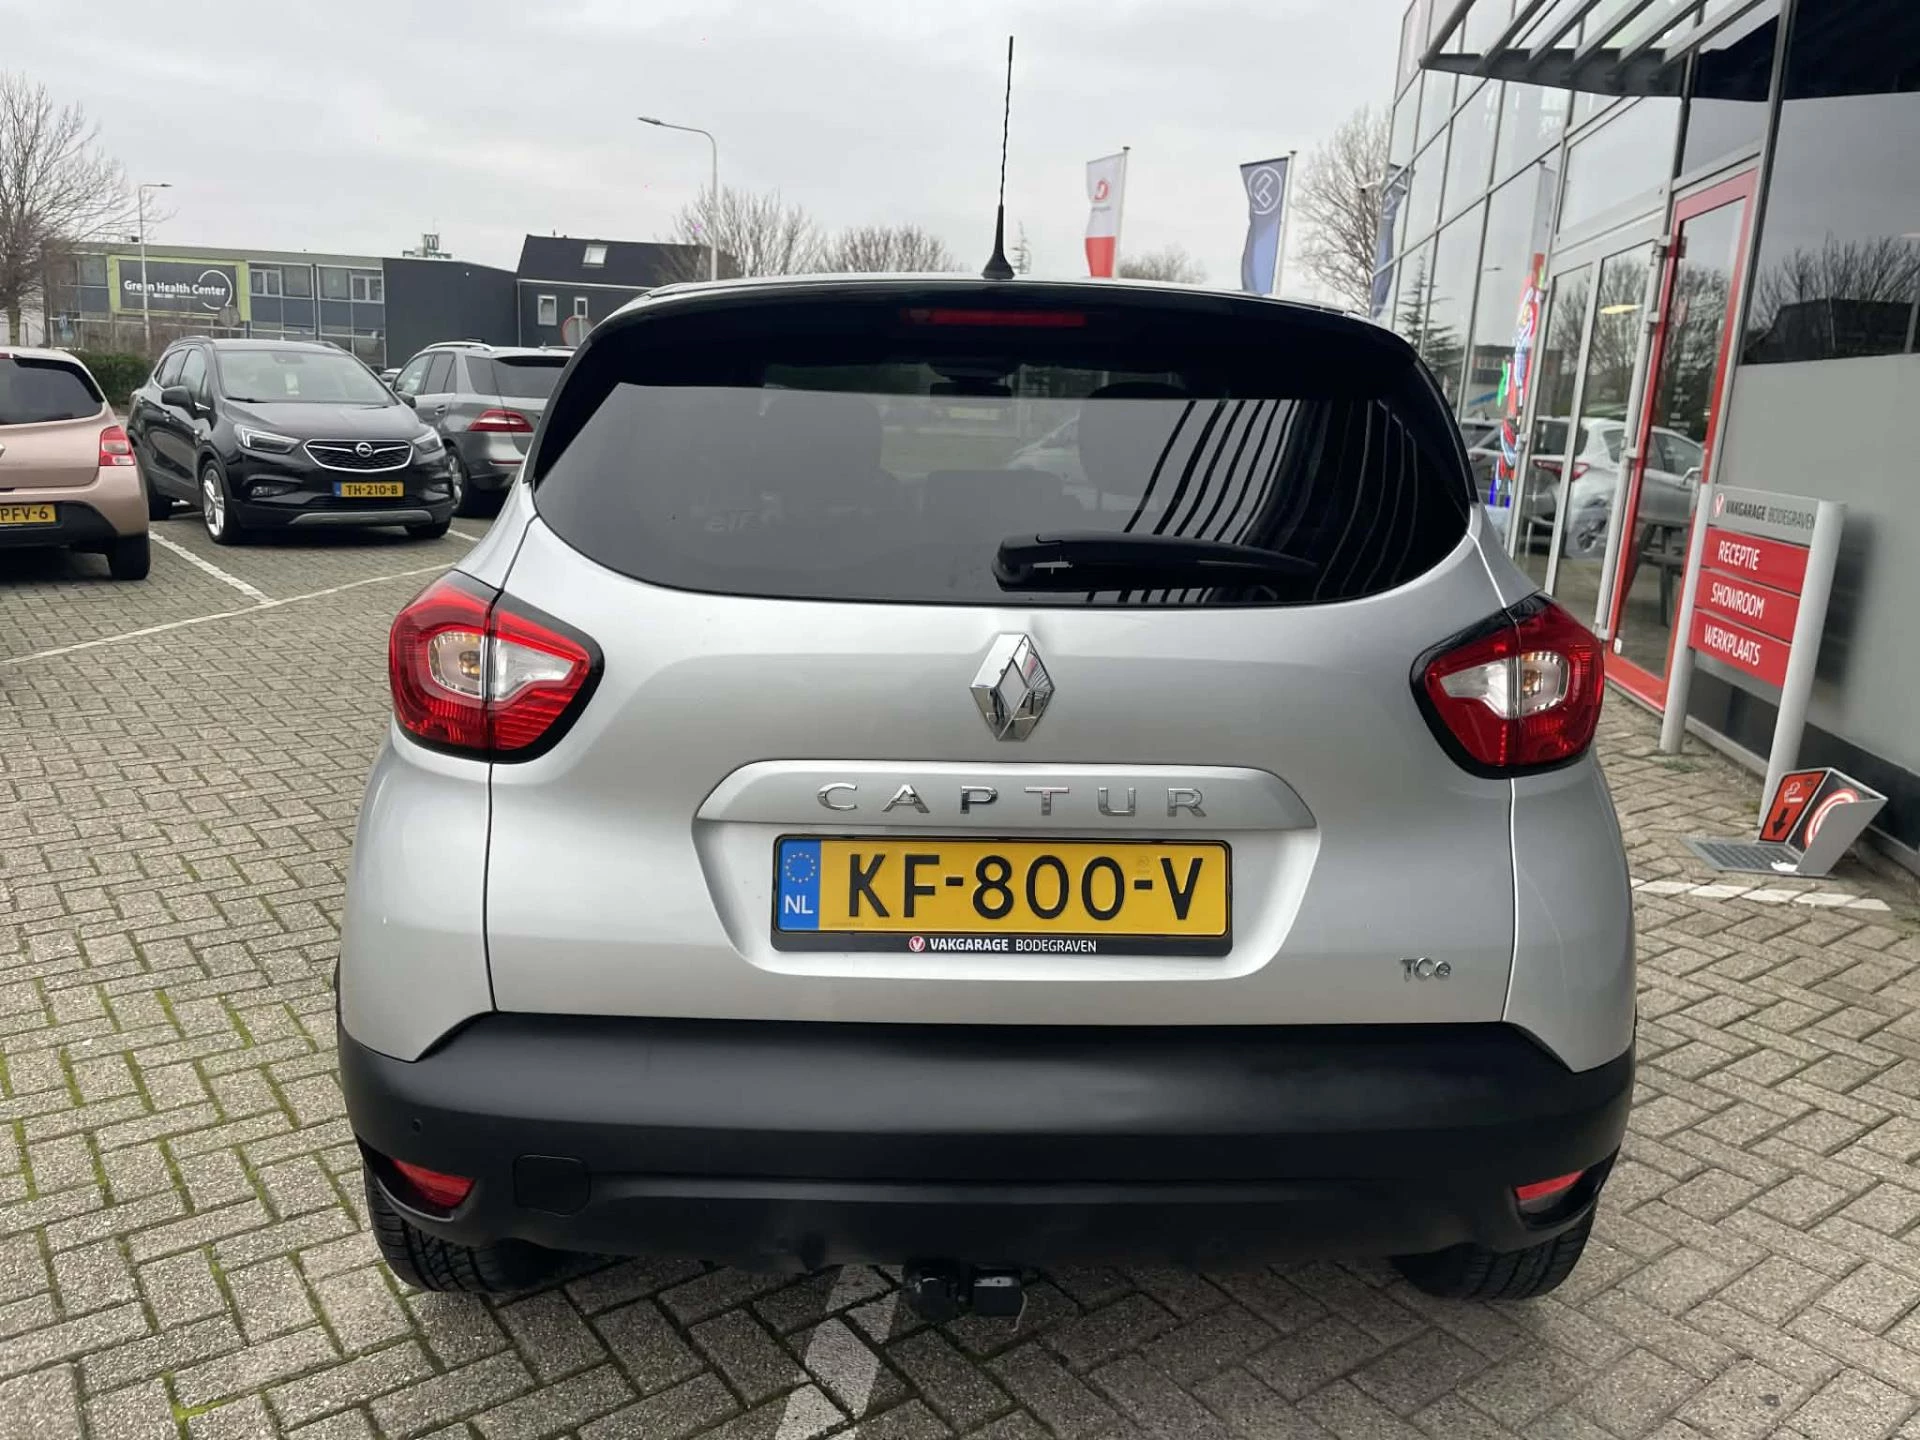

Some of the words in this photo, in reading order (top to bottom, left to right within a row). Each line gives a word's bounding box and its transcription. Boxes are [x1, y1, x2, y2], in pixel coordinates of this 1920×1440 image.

[124, 280, 155, 292] Gren
[157, 282, 190, 294] Health
[192, 284, 226, 296] Center
[345, 485, 398, 496] TH-210-B
[1726, 500, 1766, 521] VAKGARAGE
[1718, 540, 1760, 571] RECEPTIE
[1711, 582, 1765, 619] SHOWROOM
[1704, 624, 1762, 667] WERKPLAATS
[816, 782, 1207, 818] CAPTUR
[848, 854, 1203, 921] KF-800-V
[784, 894, 814, 914] NL
[929, 938, 1009, 951] VAKGARAGE
[1016, 939, 1096, 953] BODEGRAVEN
[1400, 957, 1451, 981] TCe
